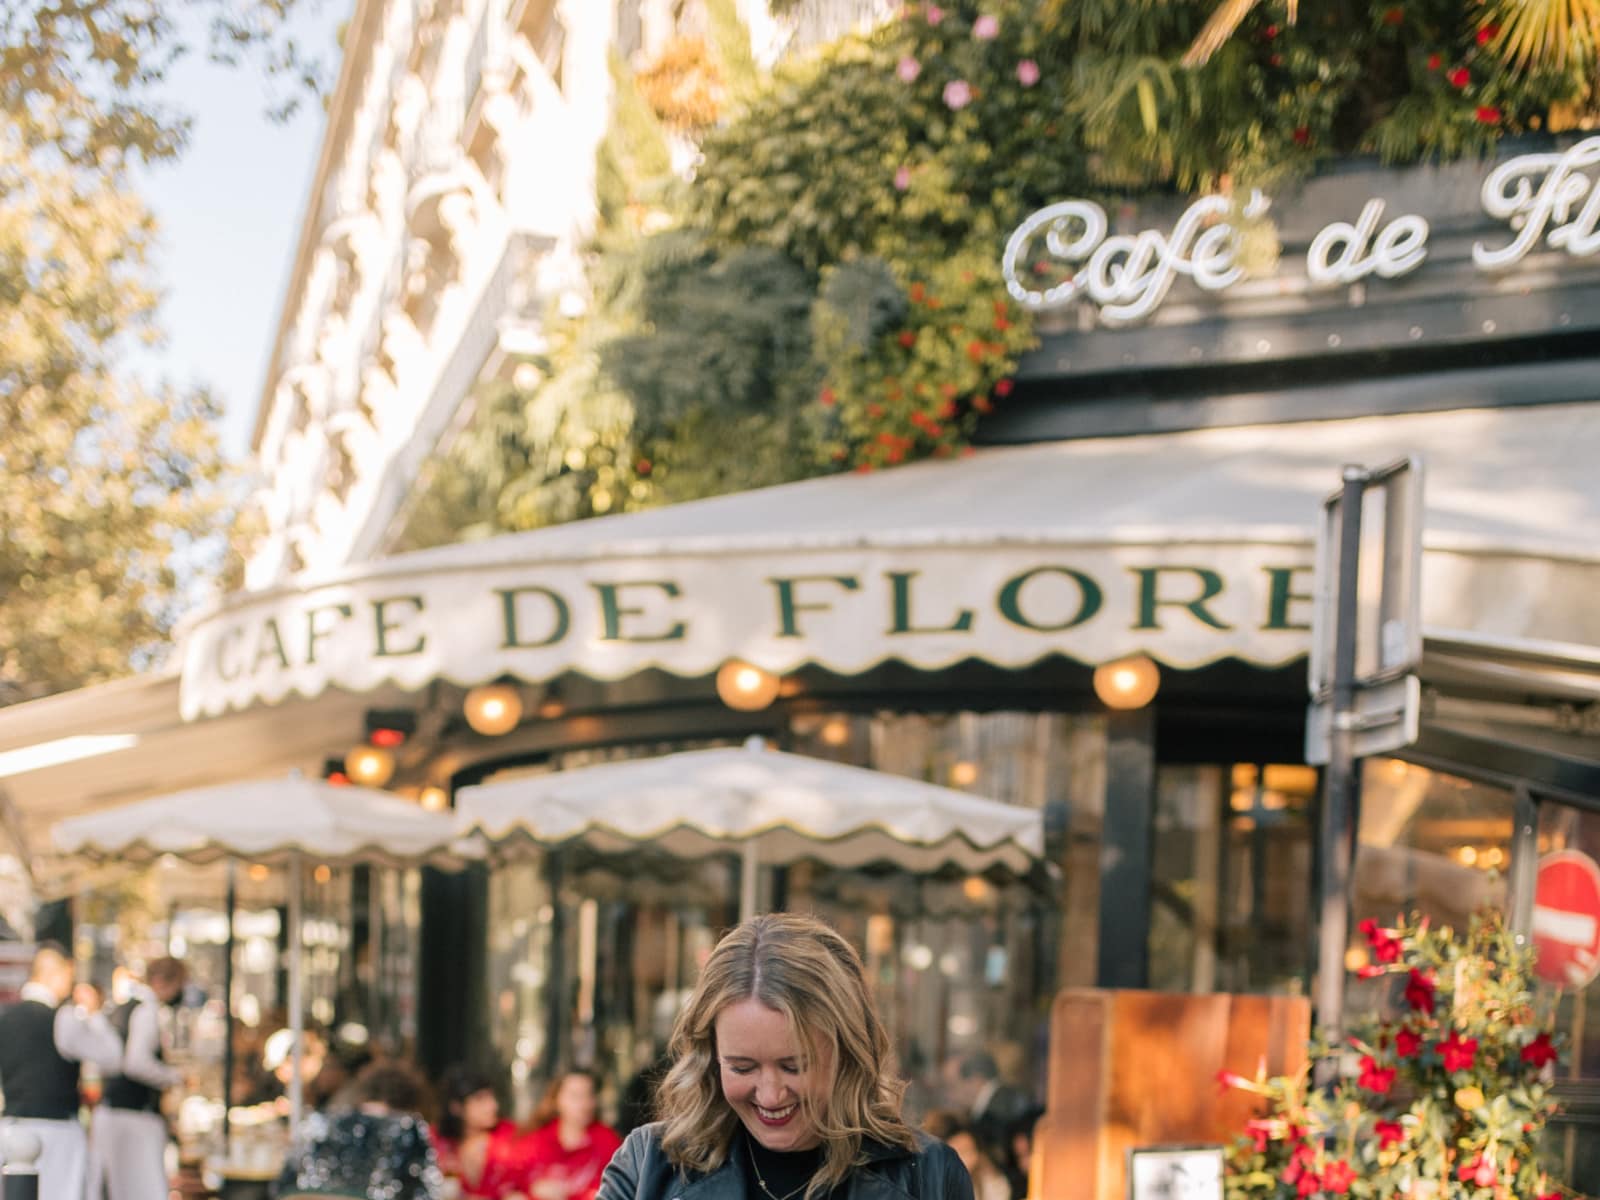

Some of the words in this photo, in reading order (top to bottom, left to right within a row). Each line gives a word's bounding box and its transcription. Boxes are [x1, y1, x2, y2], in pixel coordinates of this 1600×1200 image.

[1306, 197, 1429, 284] de
[215, 594, 427, 683] CAFE
[491, 580, 687, 649] DE
